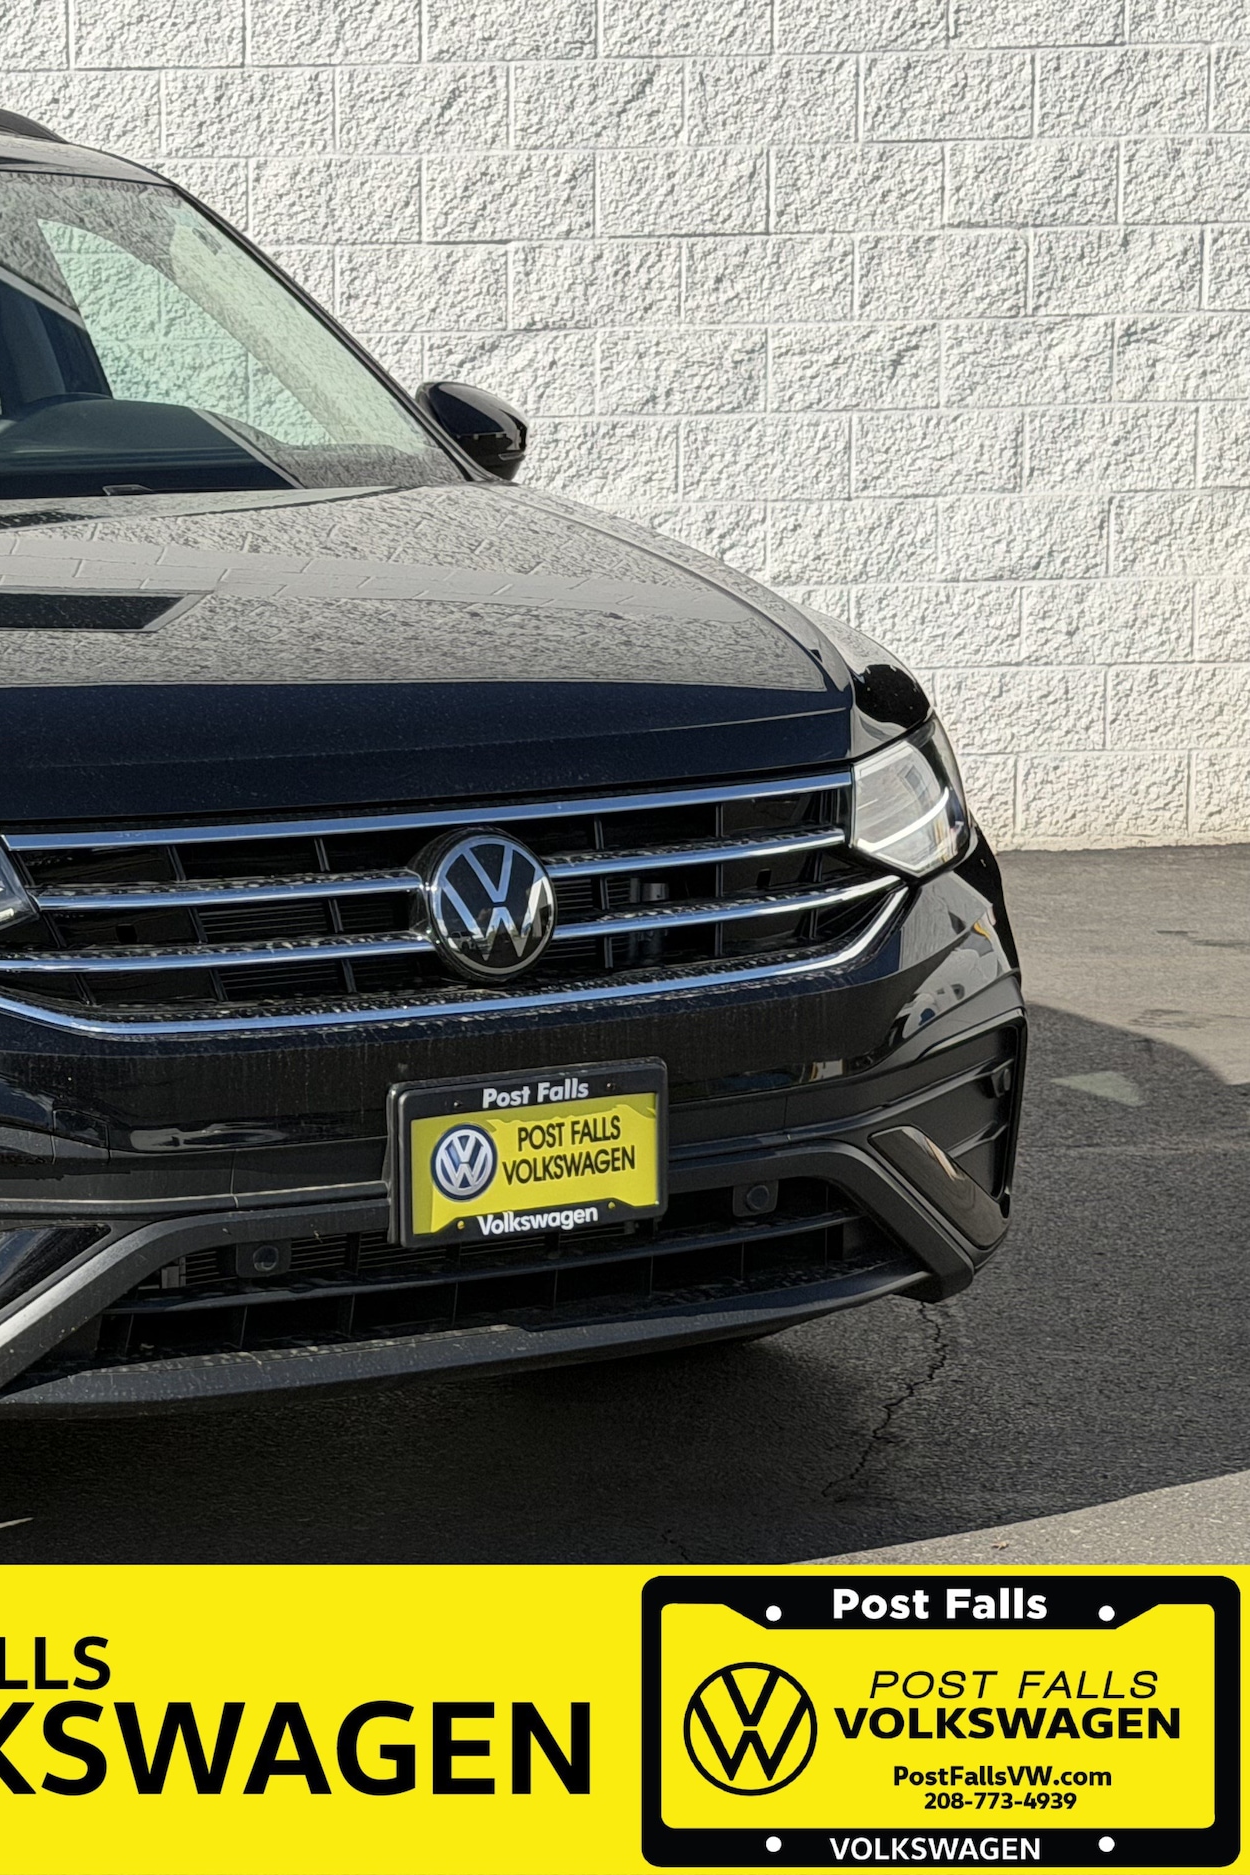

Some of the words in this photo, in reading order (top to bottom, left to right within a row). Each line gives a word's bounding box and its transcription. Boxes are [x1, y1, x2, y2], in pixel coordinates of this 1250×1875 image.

[431, 834, 554, 974] VW
[482, 1085, 530, 1108] Post
[537, 1078, 589, 1103] Falls
[517, 1122, 565, 1151] POST
[571, 1115, 621, 1145] FALLS
[434, 1126, 495, 1199] VW
[502, 1145, 635, 1185] VOLKSWAGEN
[477, 1206, 598, 1236] Volkswagen
